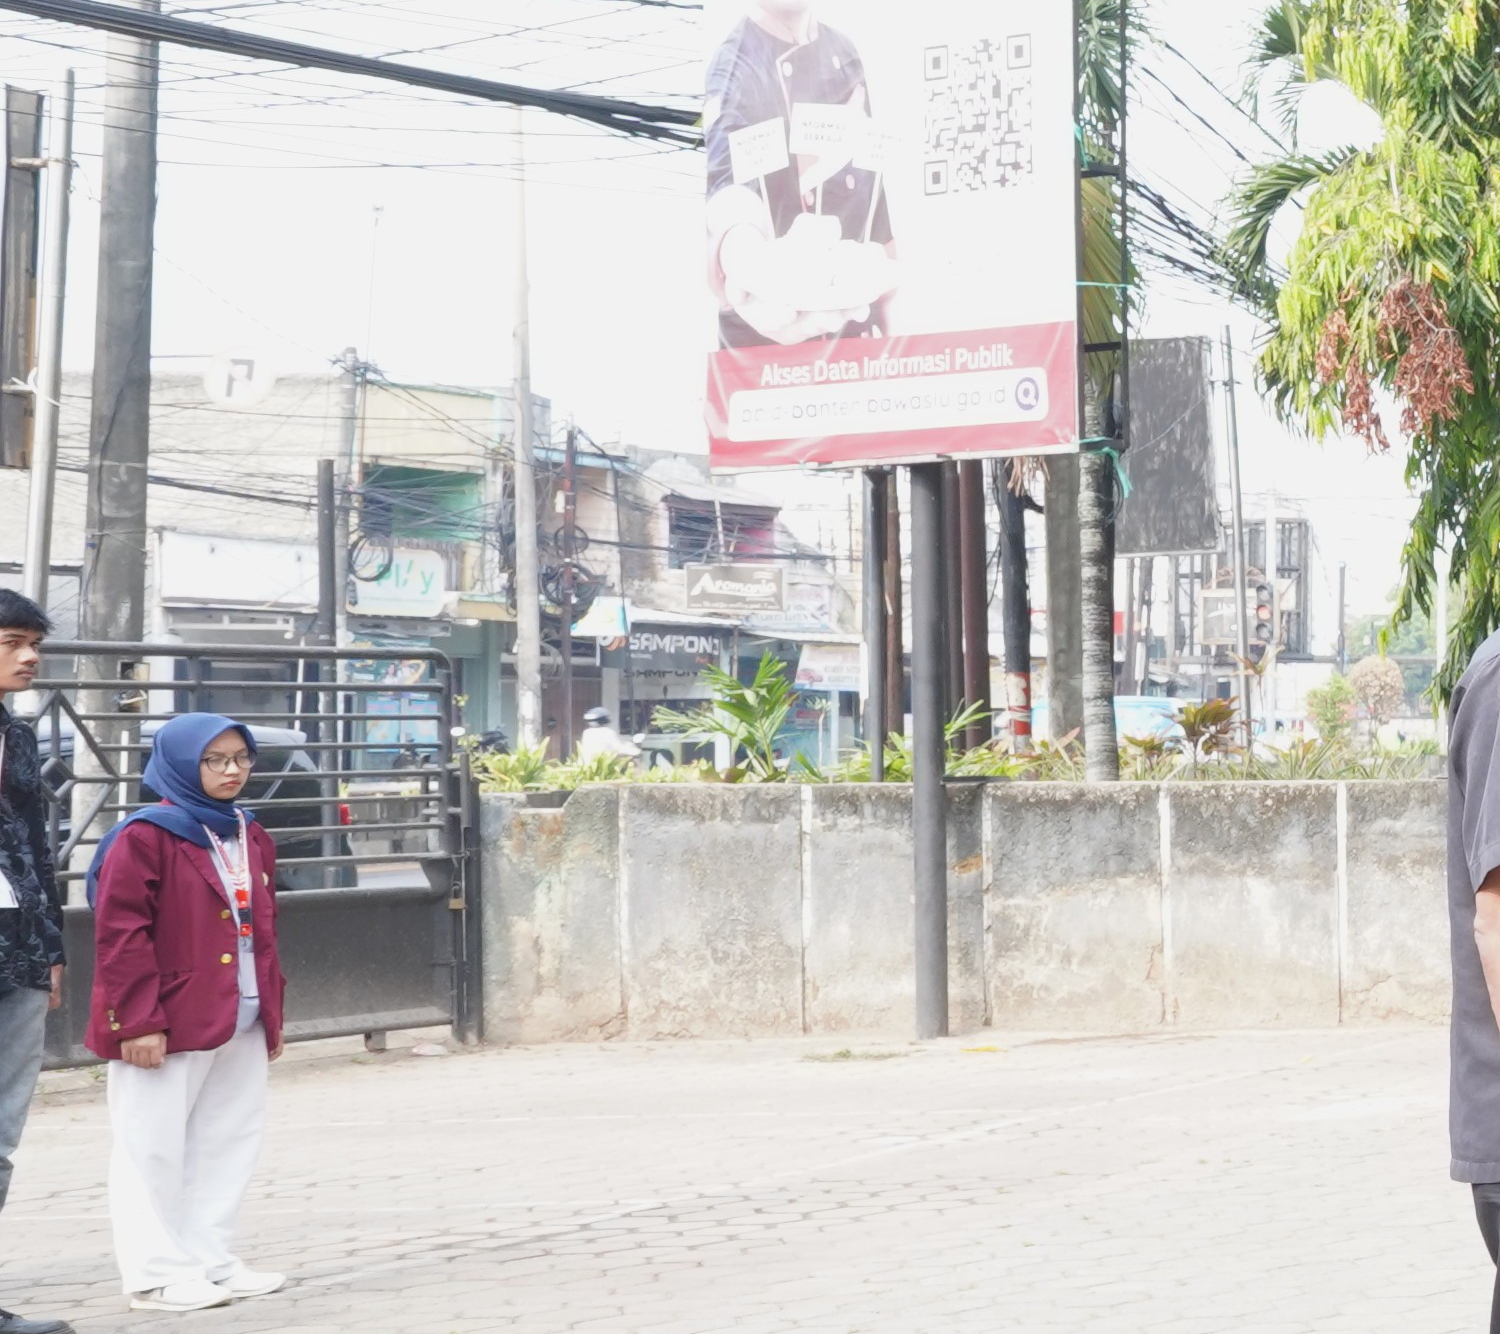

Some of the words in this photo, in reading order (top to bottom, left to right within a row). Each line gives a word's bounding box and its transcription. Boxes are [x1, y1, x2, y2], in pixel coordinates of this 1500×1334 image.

[760, 364, 811, 386] Akses
[814, 359, 860, 381] Data
[863, 348, 951, 378] Informasi
[955, 343, 1014, 370] Publik
